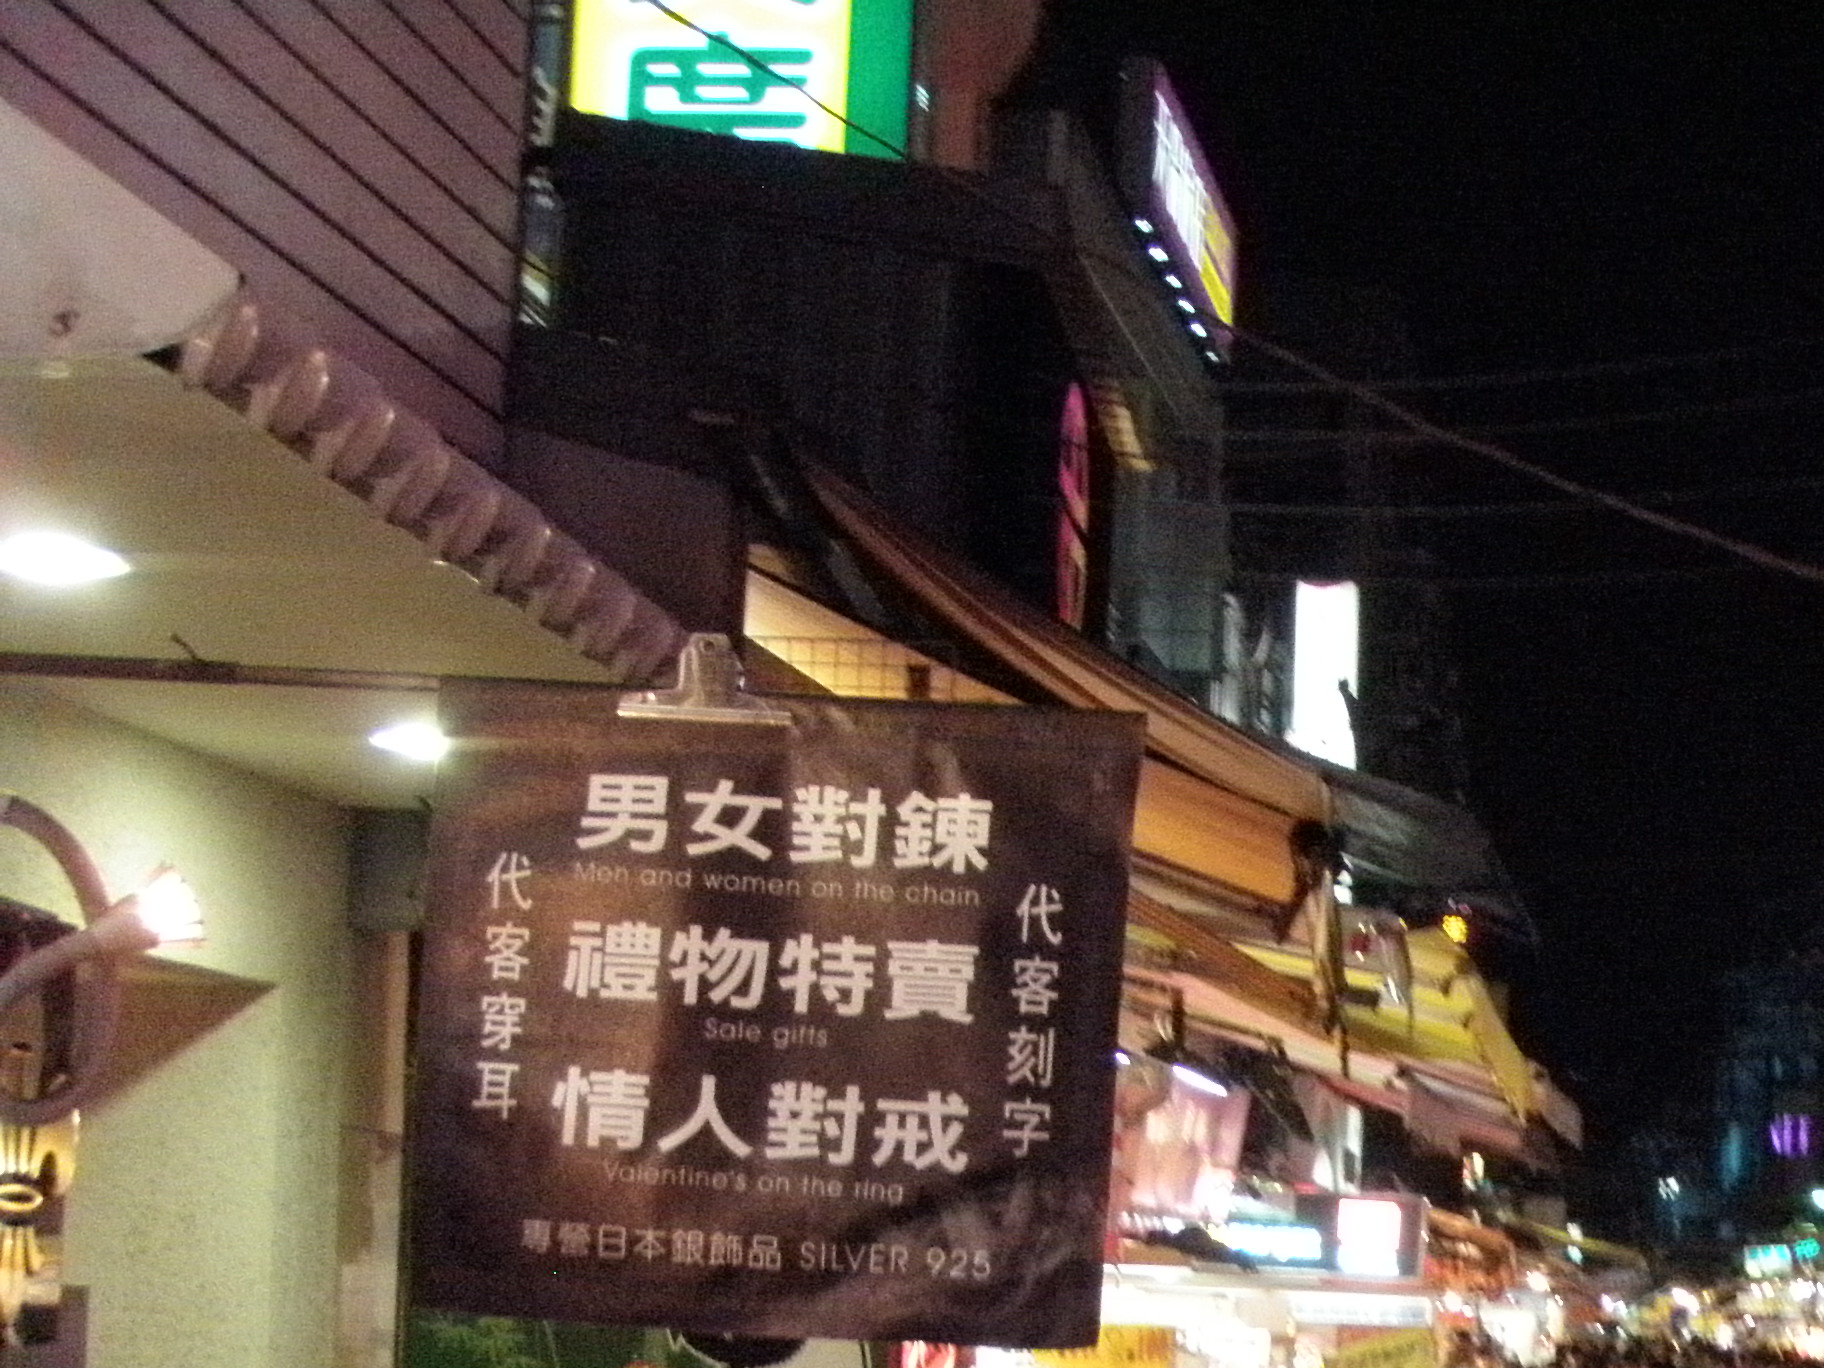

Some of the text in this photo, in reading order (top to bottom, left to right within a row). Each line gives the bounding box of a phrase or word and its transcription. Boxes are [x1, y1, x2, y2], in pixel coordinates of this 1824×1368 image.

[576, 774, 993, 874] 男女對鍊
[573, 861, 981, 907] Men and women on the chain
[472, 851, 532, 1120] 代客穿耳
[564, 920, 980, 1025] 禮物特賣
[1002, 882, 1062, 1159] 代客刻字
[704, 1016, 828, 1050] Sale gifts
[552, 1065, 968, 1174] 情人對戒
[602, 1160, 904, 1207] Valentine's on the ring
[800, 1240, 909, 1275] SILVER
[927, 1245, 993, 1282] 925
